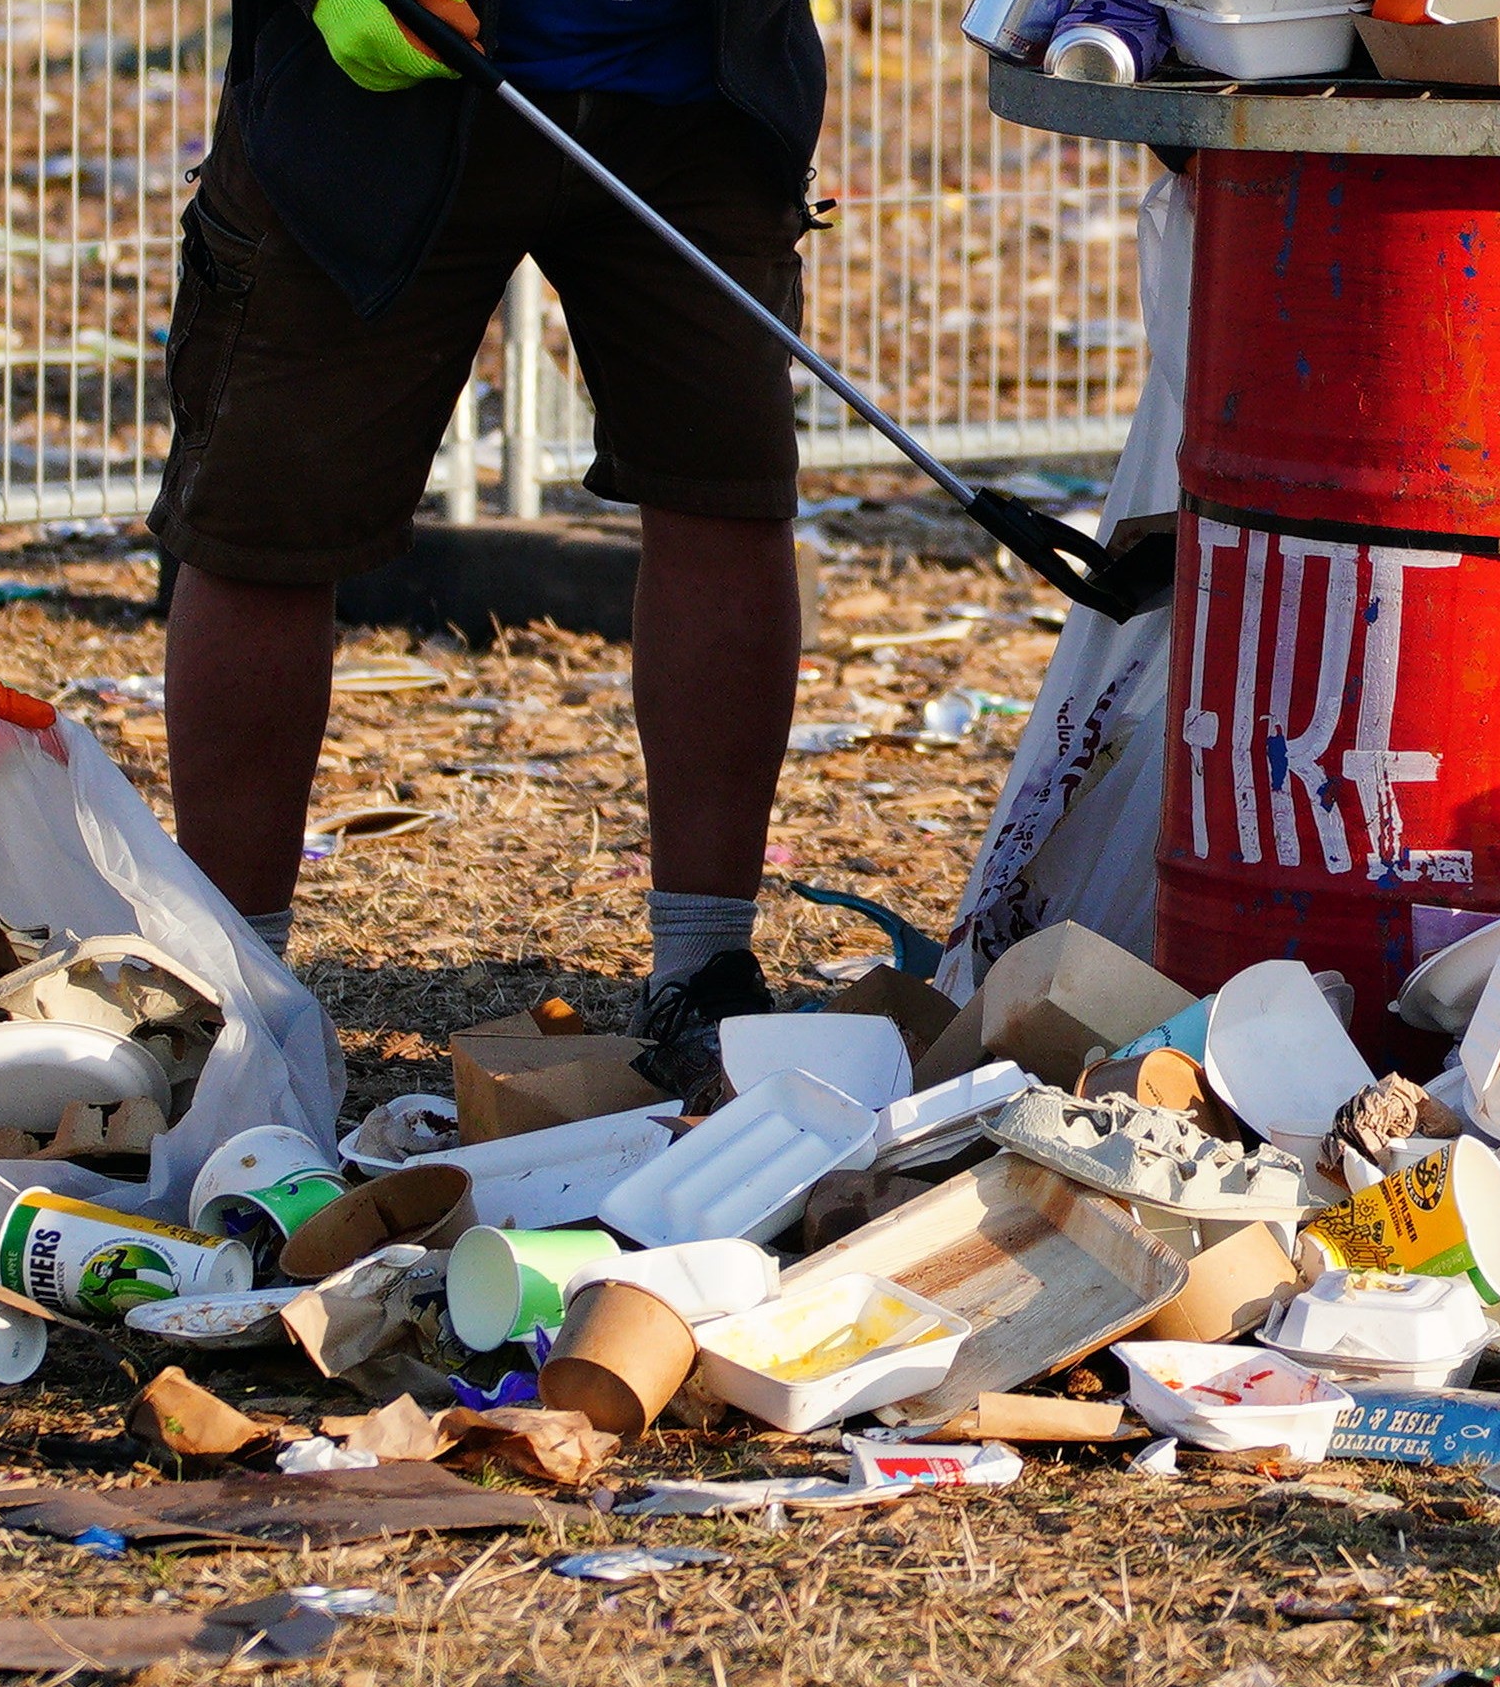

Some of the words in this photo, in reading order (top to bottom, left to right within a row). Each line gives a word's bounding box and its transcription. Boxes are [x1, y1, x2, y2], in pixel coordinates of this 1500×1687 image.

[1183, 518, 1474, 883] FIRE
[1399, 1197, 1419, 1244] PILSNER
[1387, 1409, 1445, 1436] FISH
